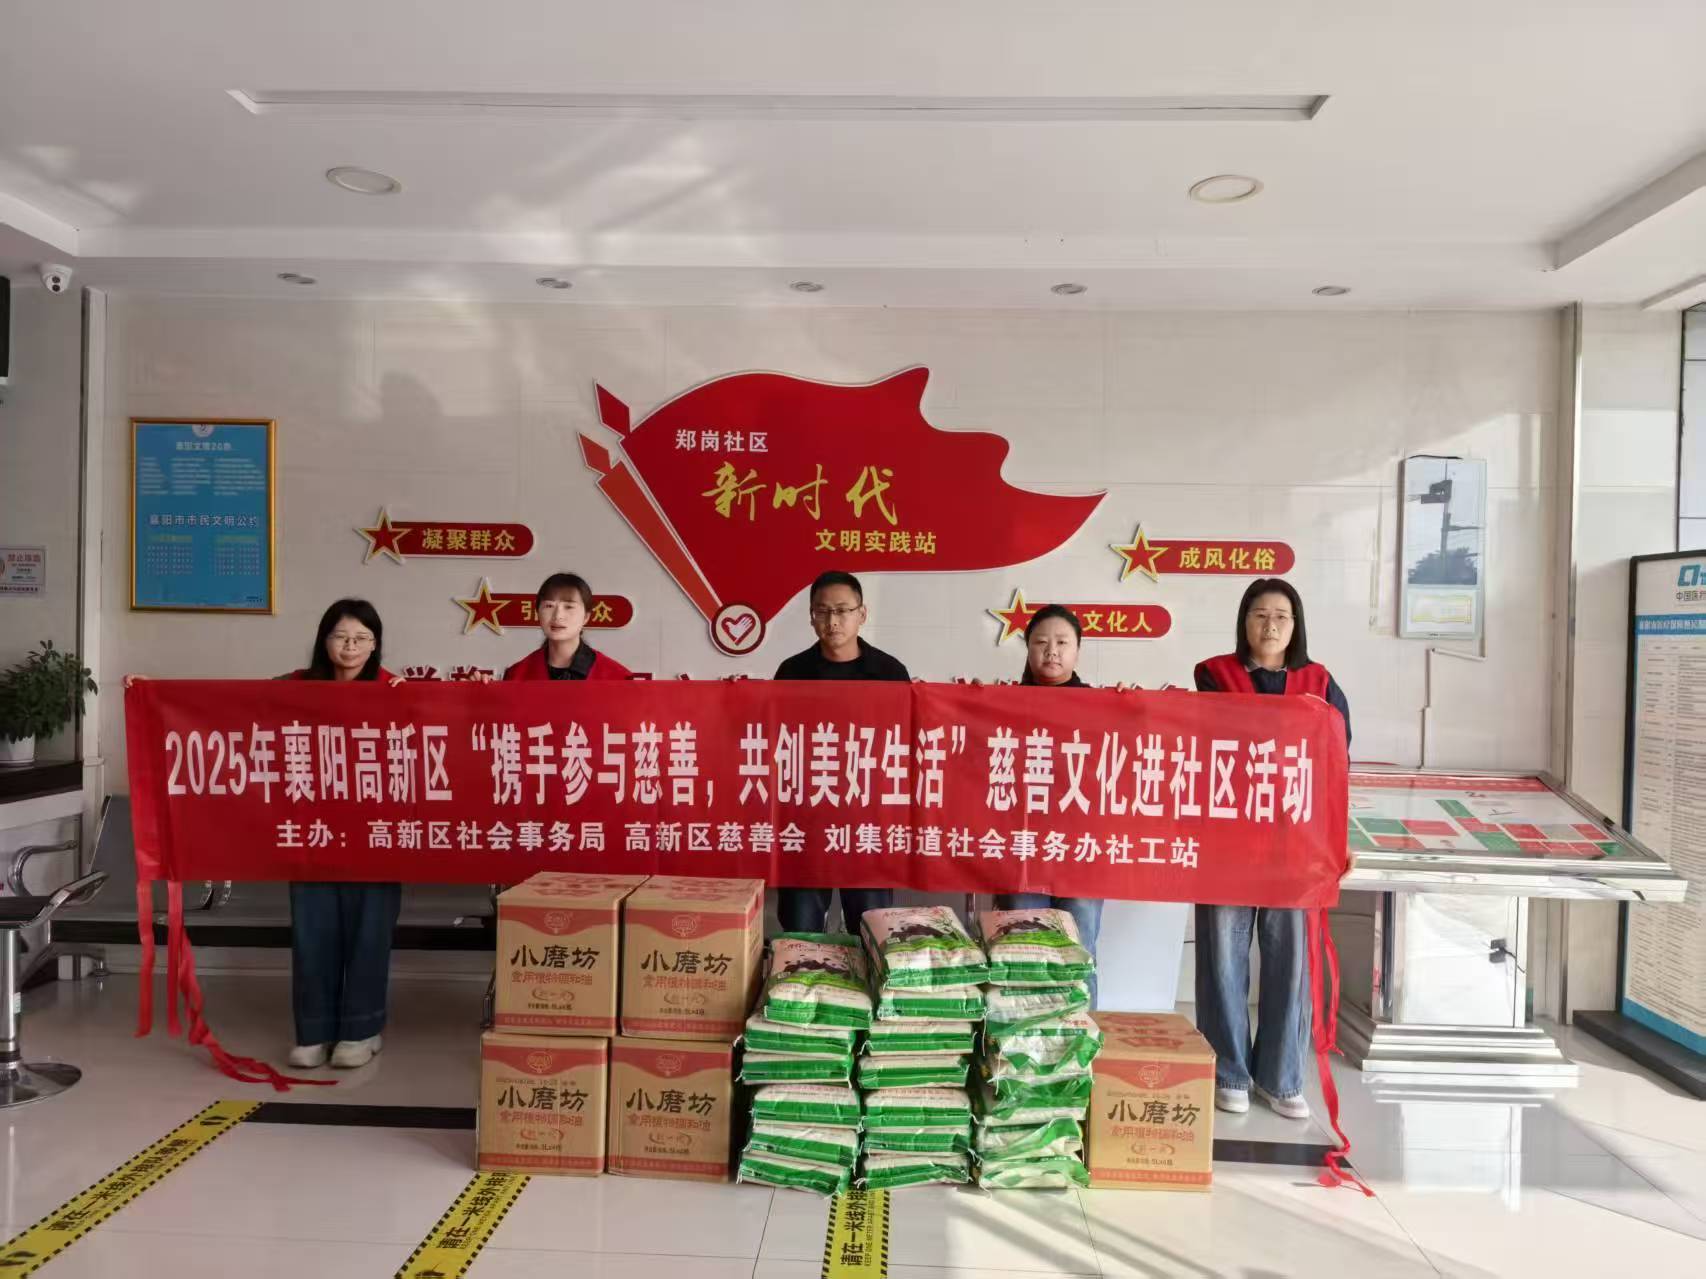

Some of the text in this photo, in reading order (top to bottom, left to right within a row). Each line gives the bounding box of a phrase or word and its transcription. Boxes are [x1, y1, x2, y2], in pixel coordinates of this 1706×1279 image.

[675, 429, 769, 453] 郑岗社区
[701, 461, 898, 525] 新时代
[149, 513, 257, 527] 襄阳市市民文明公约
[422, 526, 517, 551] 凝聚群众
[815, 528, 937, 555] 文明实践站
[1179, 547, 1276, 572] 成风化俗
[1072, 610, 1153, 633] 文化人
[625, 820, 806, 855] 高新区慈善会
[824, 823, 1200, 869] 刘集街道社会事务办社工站
[510, 944, 600, 970] 小磨坊
[641, 949, 733, 976] 小磨坊
[497, 1085, 589, 1112] 小磨坊
[626, 1087, 717, 1117] 小磨坊
[1107, 1099, 1201, 1126] 小磨坊
